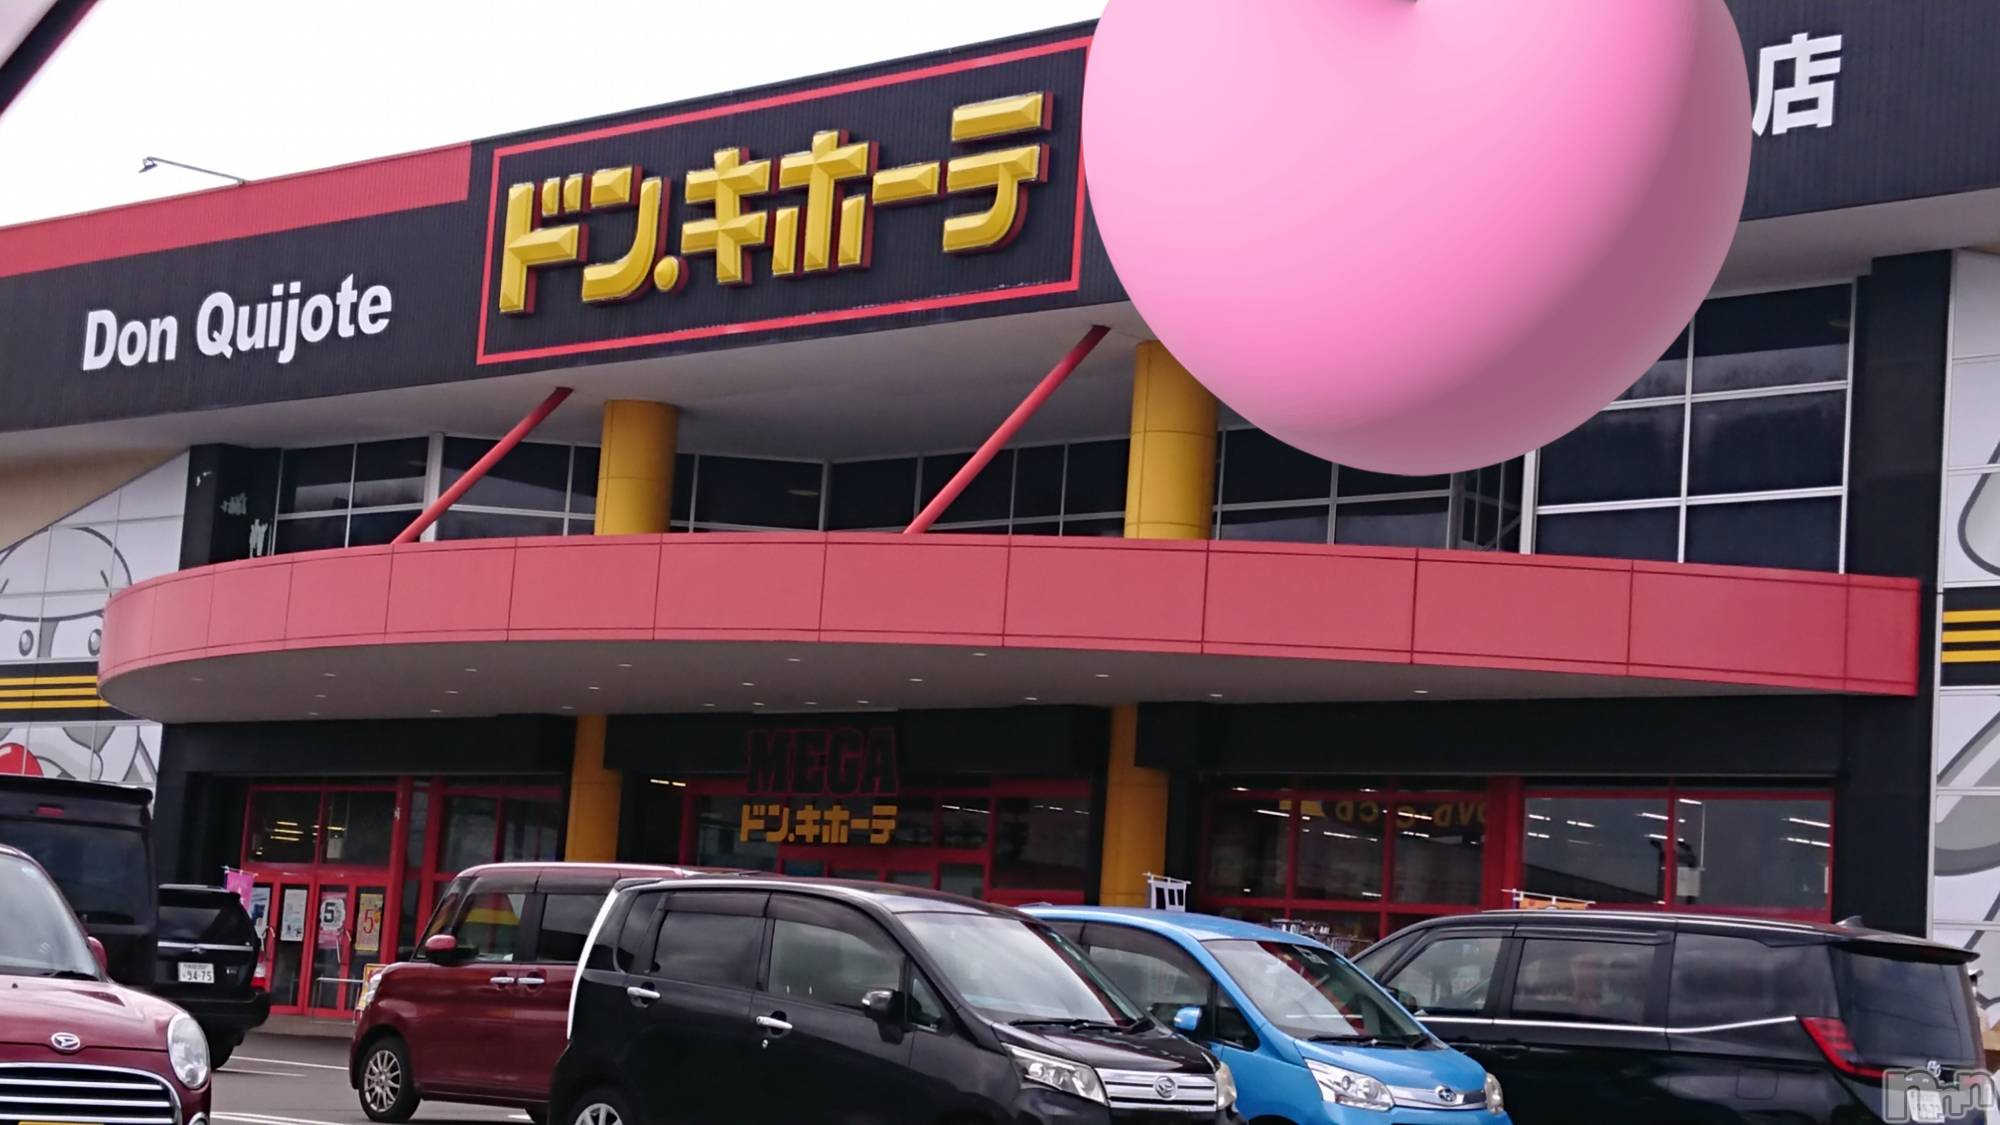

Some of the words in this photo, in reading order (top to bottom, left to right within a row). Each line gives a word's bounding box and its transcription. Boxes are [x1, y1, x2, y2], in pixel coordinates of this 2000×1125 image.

[1751, 32, 1842, 136] 店
[82, 309, 178, 371] Don
[196, 273, 393, 364] Quijote
[745, 727, 899, 798] MEGA
